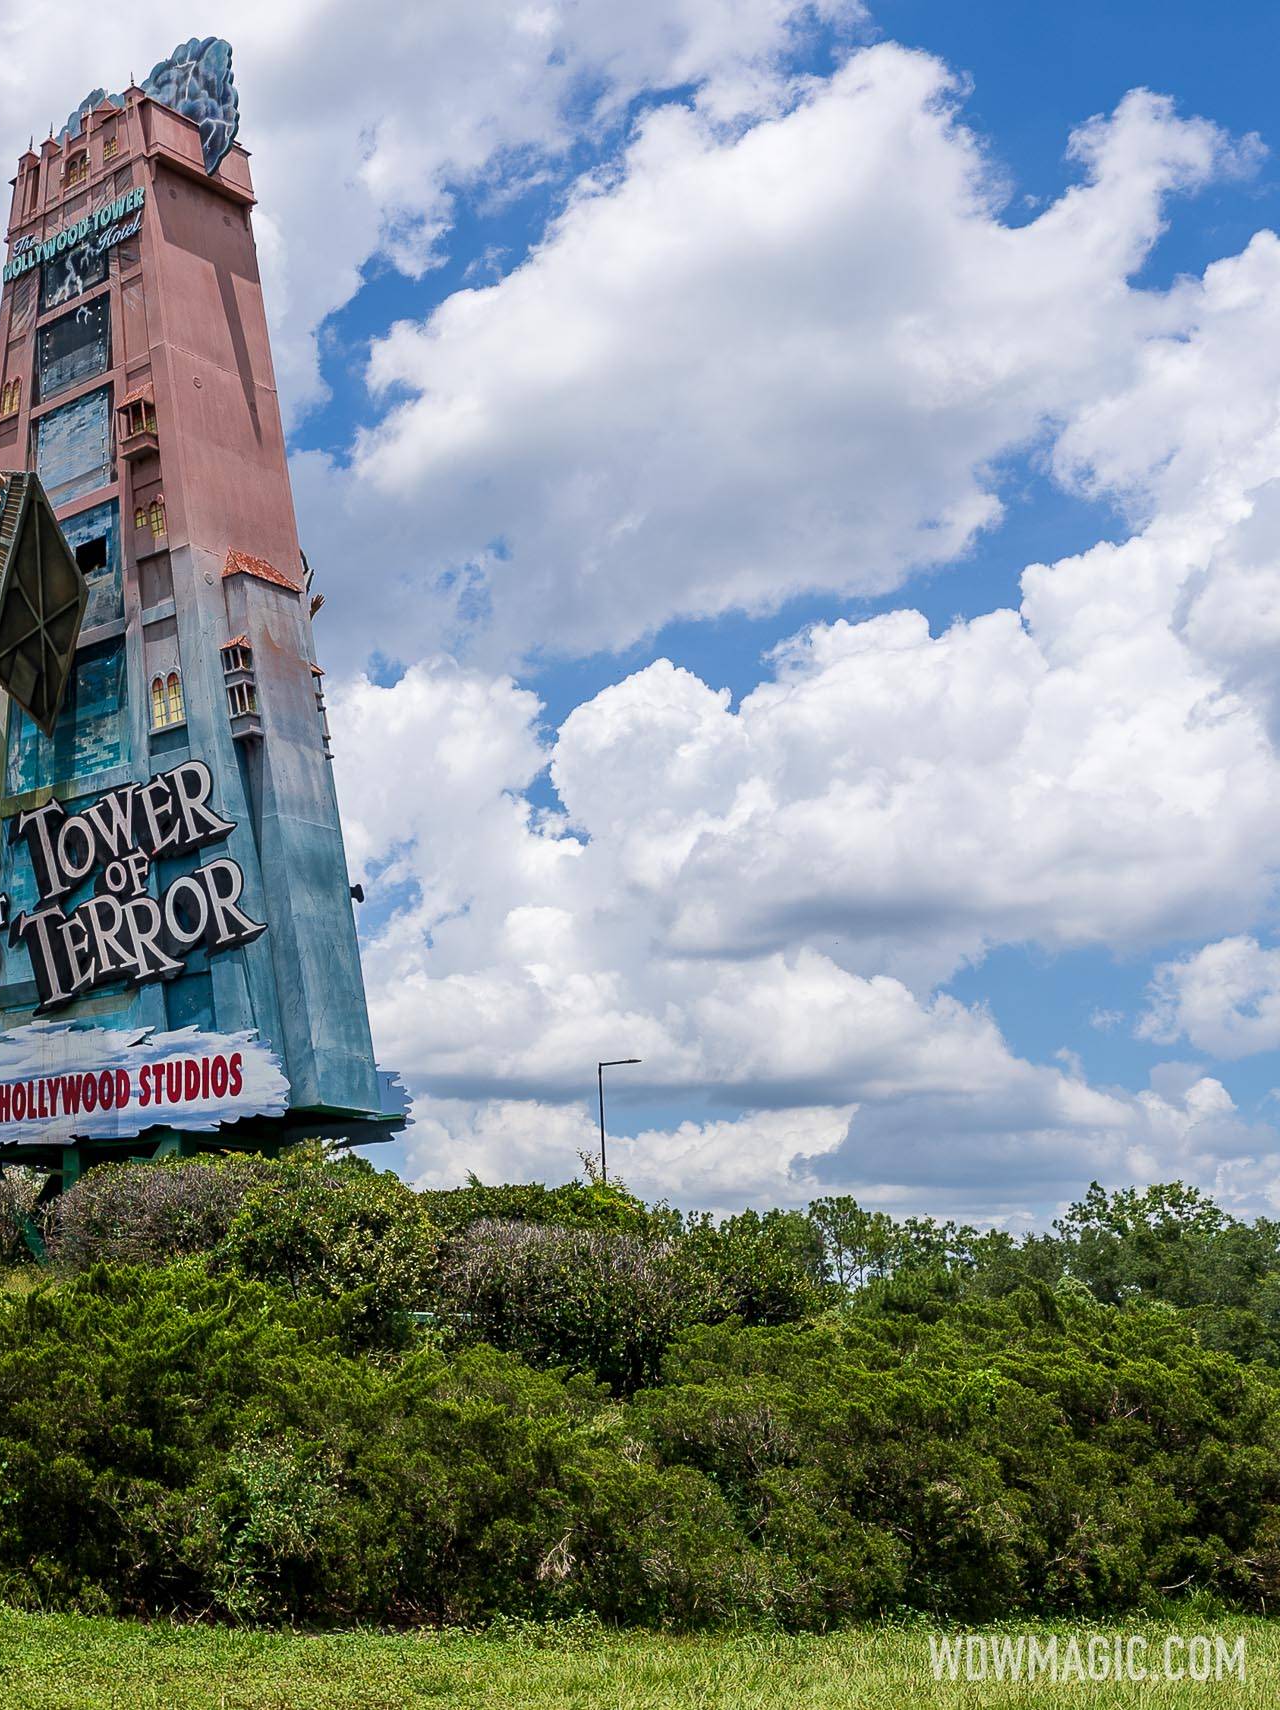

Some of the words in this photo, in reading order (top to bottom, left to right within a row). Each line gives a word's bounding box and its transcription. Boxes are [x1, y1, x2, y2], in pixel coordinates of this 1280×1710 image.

[3, 220, 90, 282] HOLLYWOOD
[92, 186, 145, 231] TOWER
[13, 234, 38, 257] The
[97, 211, 142, 253] Hotel
[19, 761, 237, 899] TOWER
[105, 851, 150, 897] OF
[19, 859, 267, 1006] TERROR
[138, 1052, 243, 1107] STUDIOS
